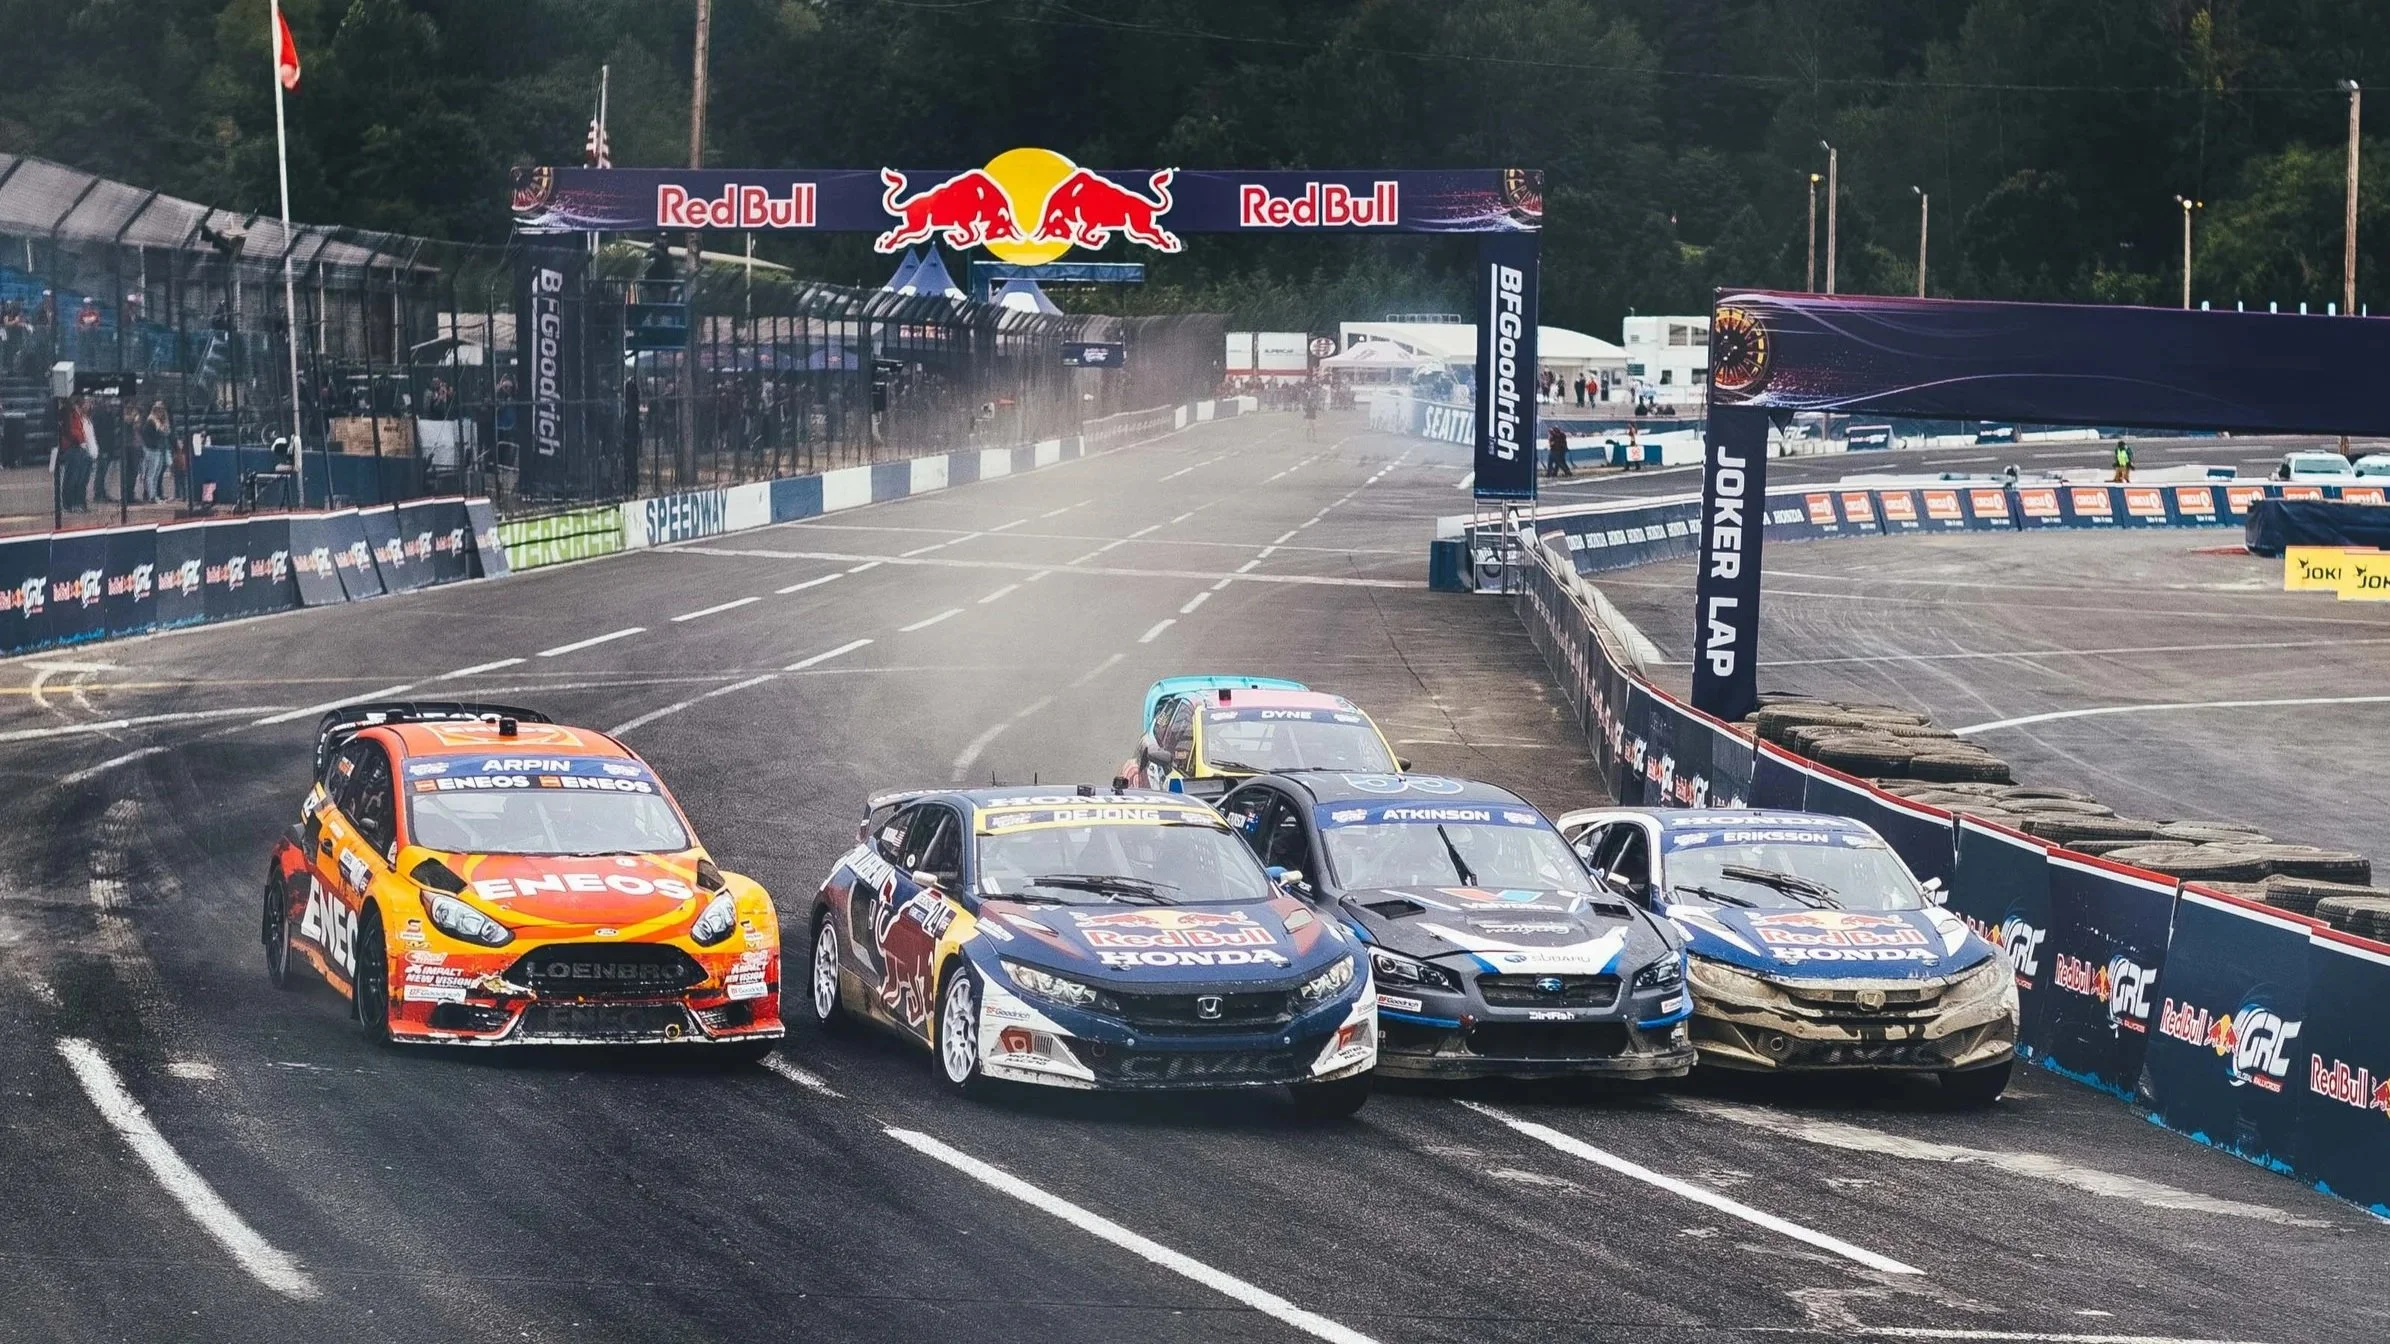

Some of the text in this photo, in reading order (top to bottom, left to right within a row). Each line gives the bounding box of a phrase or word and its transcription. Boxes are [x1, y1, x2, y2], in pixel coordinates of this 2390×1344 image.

[657, 183, 817, 229] Red Bull
[1240, 181, 1399, 228] Red Bull
[539, 267, 563, 457] BFGoodrich
[1496, 265, 1523, 461] BFGoodrich
[1422, 405, 1475, 446] SEATTL
[646, 489, 728, 545] SPEEDWAY
[1773, 509, 1805, 524] HONDA
[1707, 445, 1746, 677] JOKER LAP
[2302, 567, 2341, 580] JOK
[1261, 710, 1312, 719] DYNE
[482, 759, 571, 772] ARPIN
[436, 776, 652, 794] ENEOS ENEOS
[1053, 809, 1160, 822] DEJONG
[1383, 809, 1491, 821] ATKINSON
[1723, 832, 1830, 843] ERIKSSON
[473, 873, 694, 901] ENEOS
[301, 874, 359, 978] ENEO
[1081, 928, 1278, 947] Red Bull
[1755, 928, 1930, 946] Red Bull
[1096, 949, 1289, 966] HONDA
[1768, 946, 1940, 961] HONDA
[405, 974, 435, 983] NEW
[422, 966, 464, 977] IMPACT
[526, 962, 685, 980] LOENBRO
[2160, 998, 2187, 1040] Red
[2182, 1004, 2208, 1047] Bull
[2310, 1053, 2368, 1109] Red Bull
